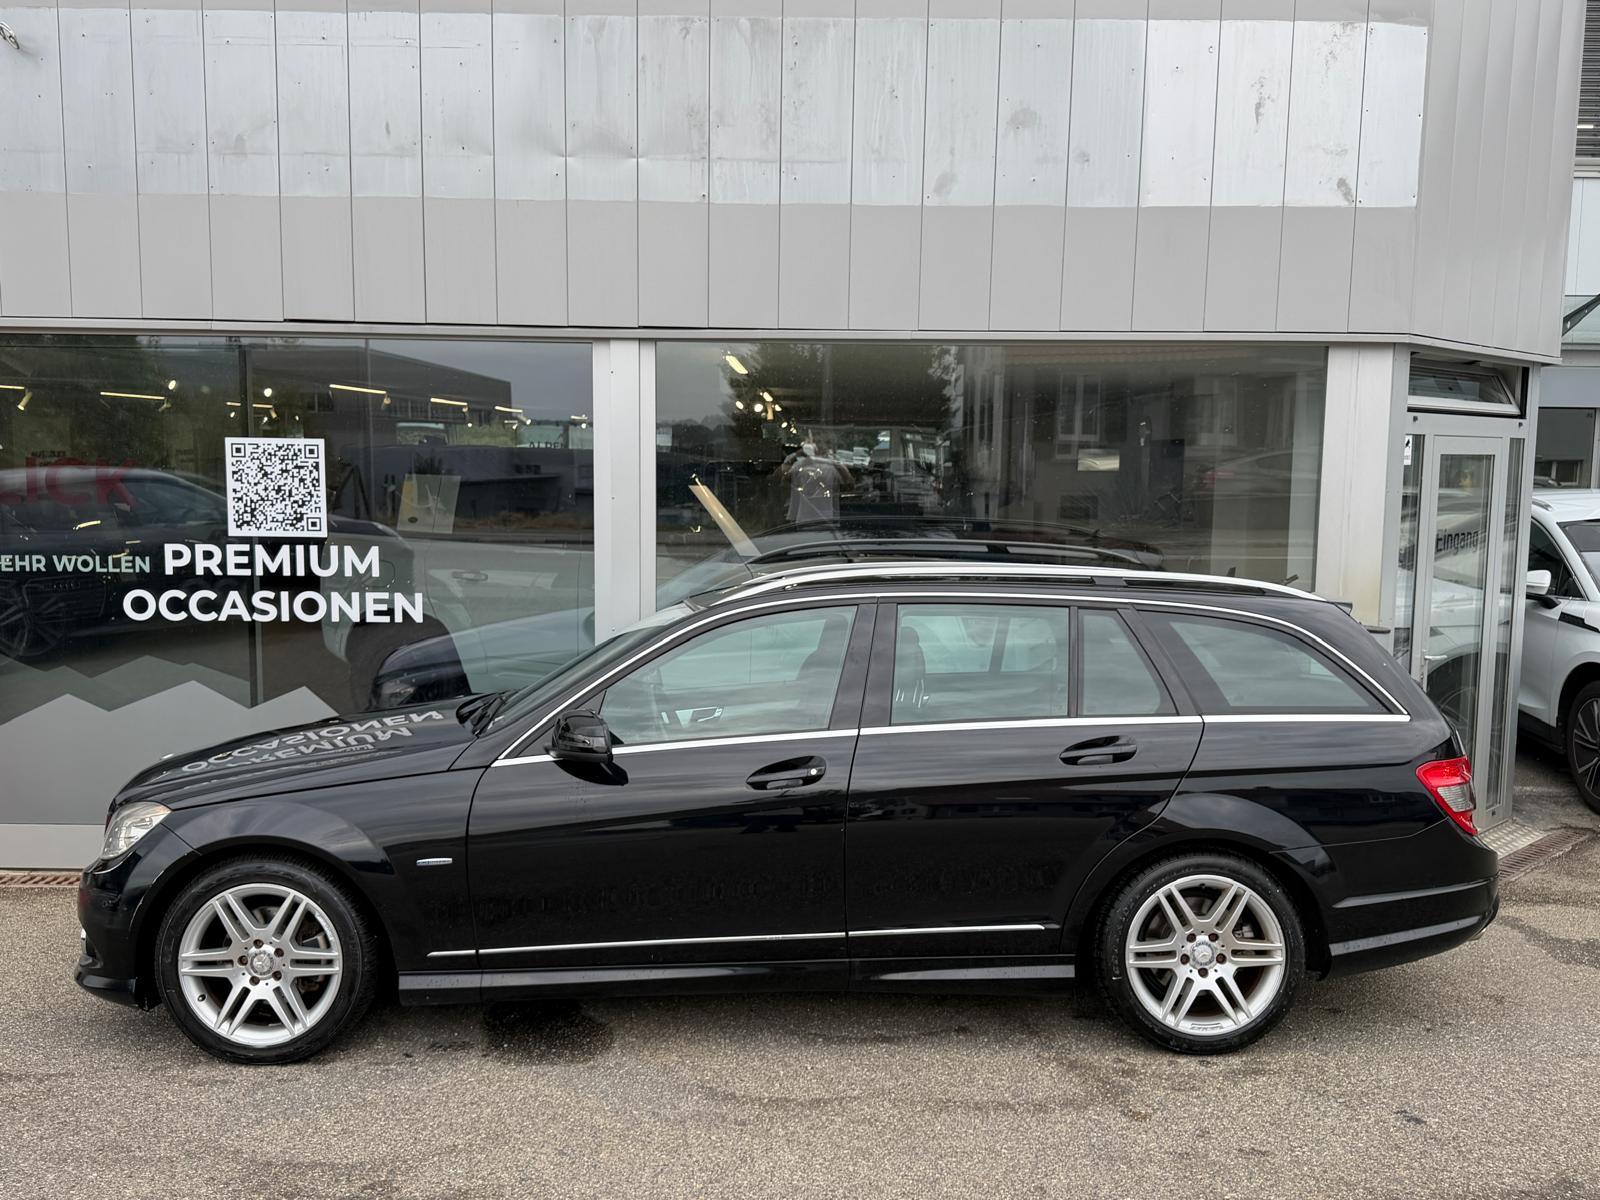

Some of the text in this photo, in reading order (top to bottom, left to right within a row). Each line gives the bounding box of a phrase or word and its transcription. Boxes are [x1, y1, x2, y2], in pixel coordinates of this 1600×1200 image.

[1435, 529, 1479, 555] Eingang
[52, 554, 151, 573] WOLLEN
[164, 543, 380, 577] PREMIUM
[123, 589, 424, 623] OCCASIONEN
